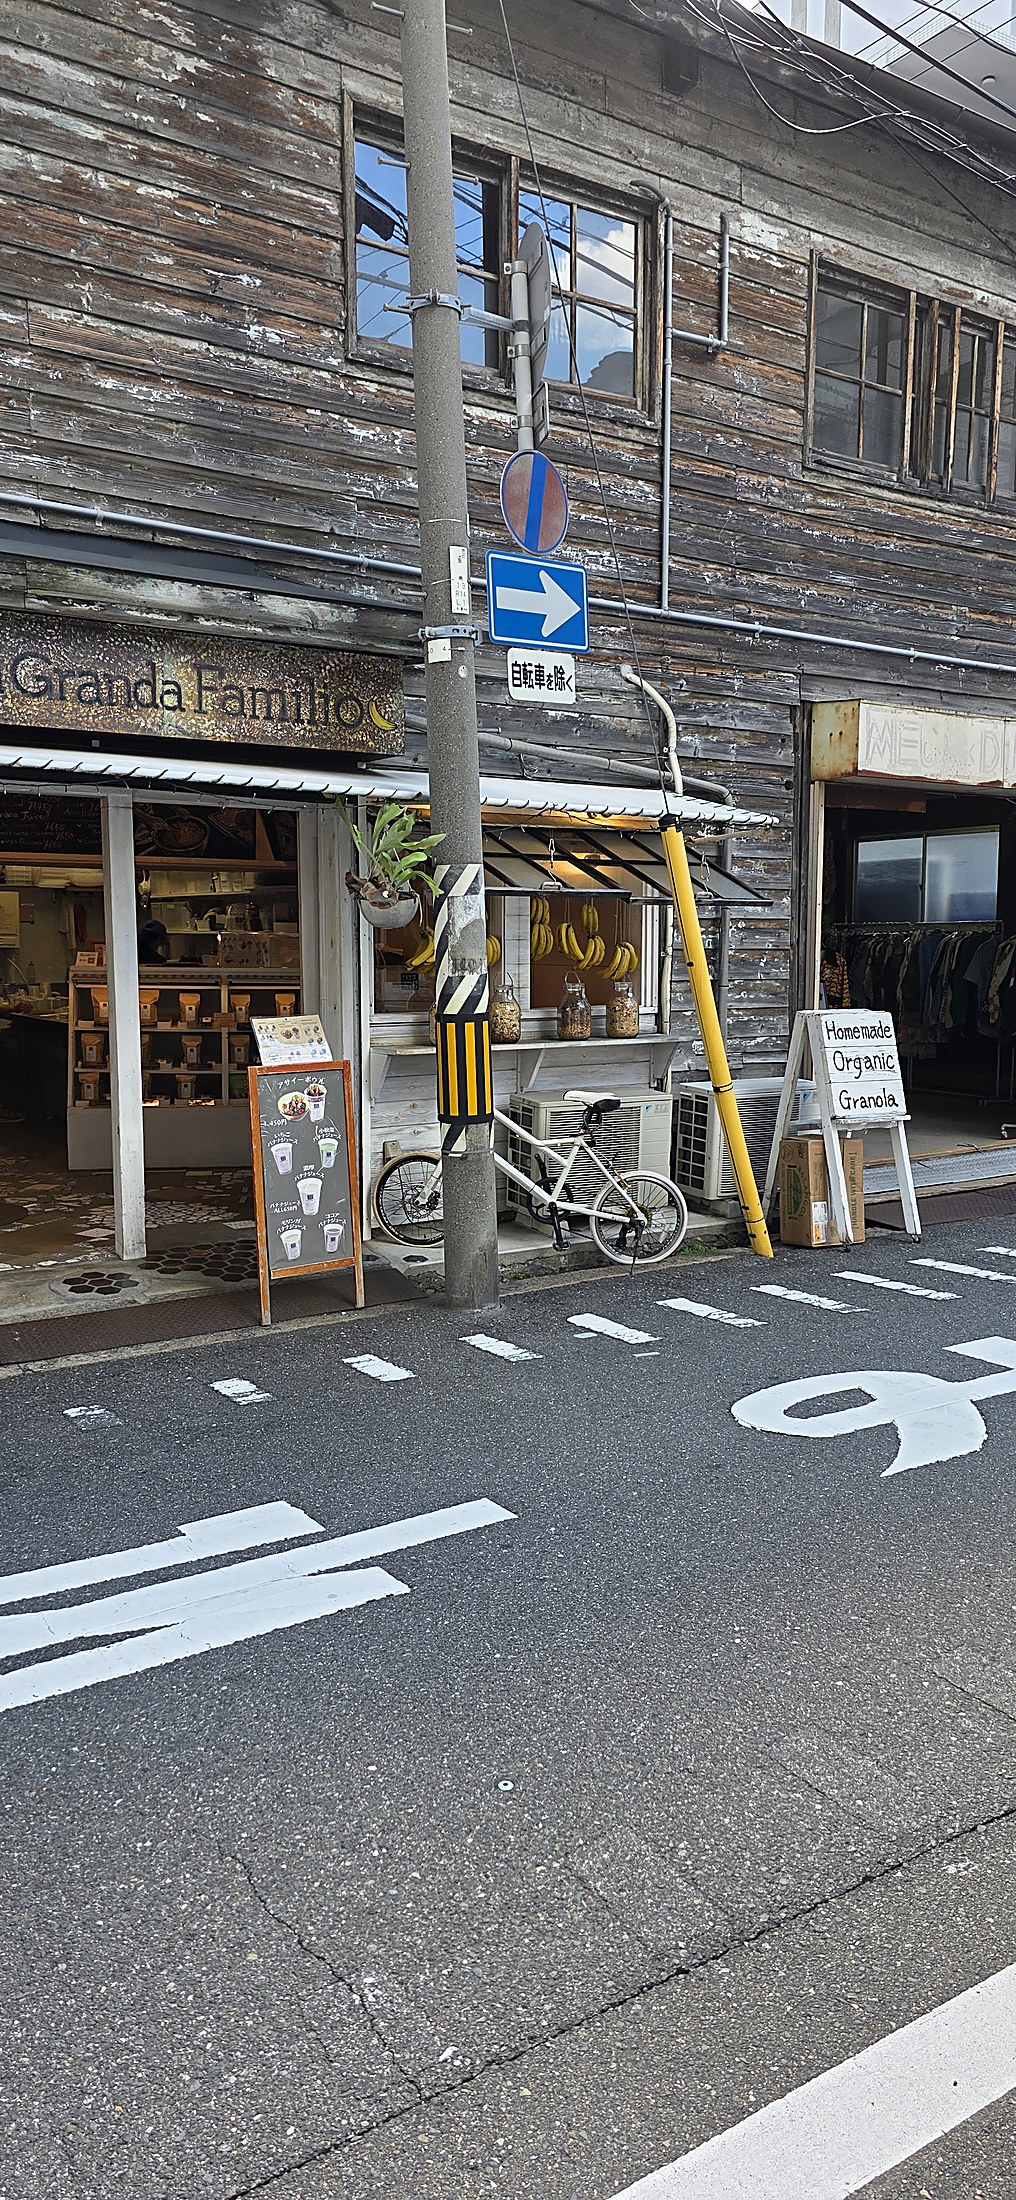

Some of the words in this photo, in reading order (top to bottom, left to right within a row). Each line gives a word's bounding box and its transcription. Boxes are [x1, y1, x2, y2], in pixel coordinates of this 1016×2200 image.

[510, 660, 574, 693] 自転車を除く
[195, 662, 366, 730] Familio
[824, 1019, 893, 1041] Homemade
[832, 1050, 896, 1080] Organic
[276, 1076, 325, 1089] アサイーボウル
[838, 1087, 899, 1111] Granola
